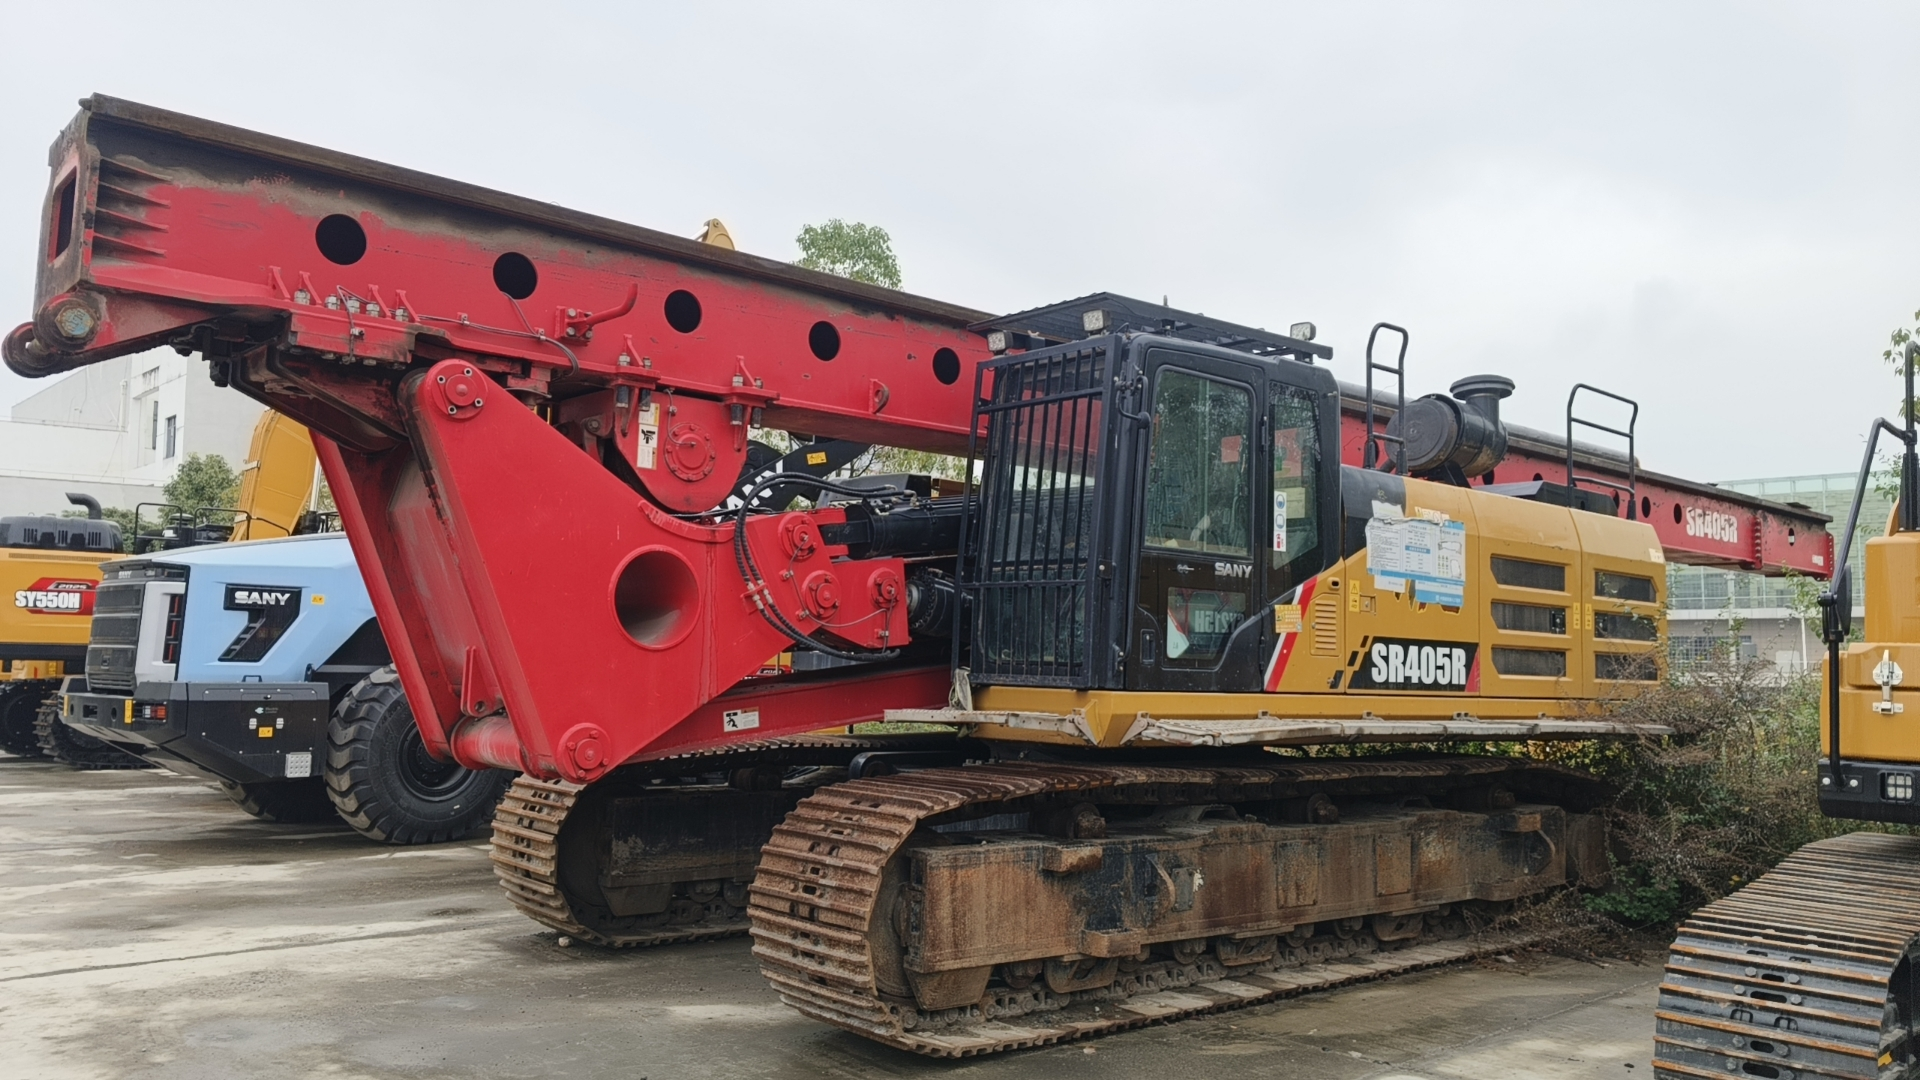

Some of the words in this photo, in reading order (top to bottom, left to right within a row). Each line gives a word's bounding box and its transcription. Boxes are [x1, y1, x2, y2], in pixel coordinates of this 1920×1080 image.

[1686, 507, 1738, 543] SR405R
[1214, 562, 1253, 578] SANY
[15, 590, 81, 609] SY550H
[234, 591, 291, 605] SANY
[1371, 643, 1466, 685] SR405R
